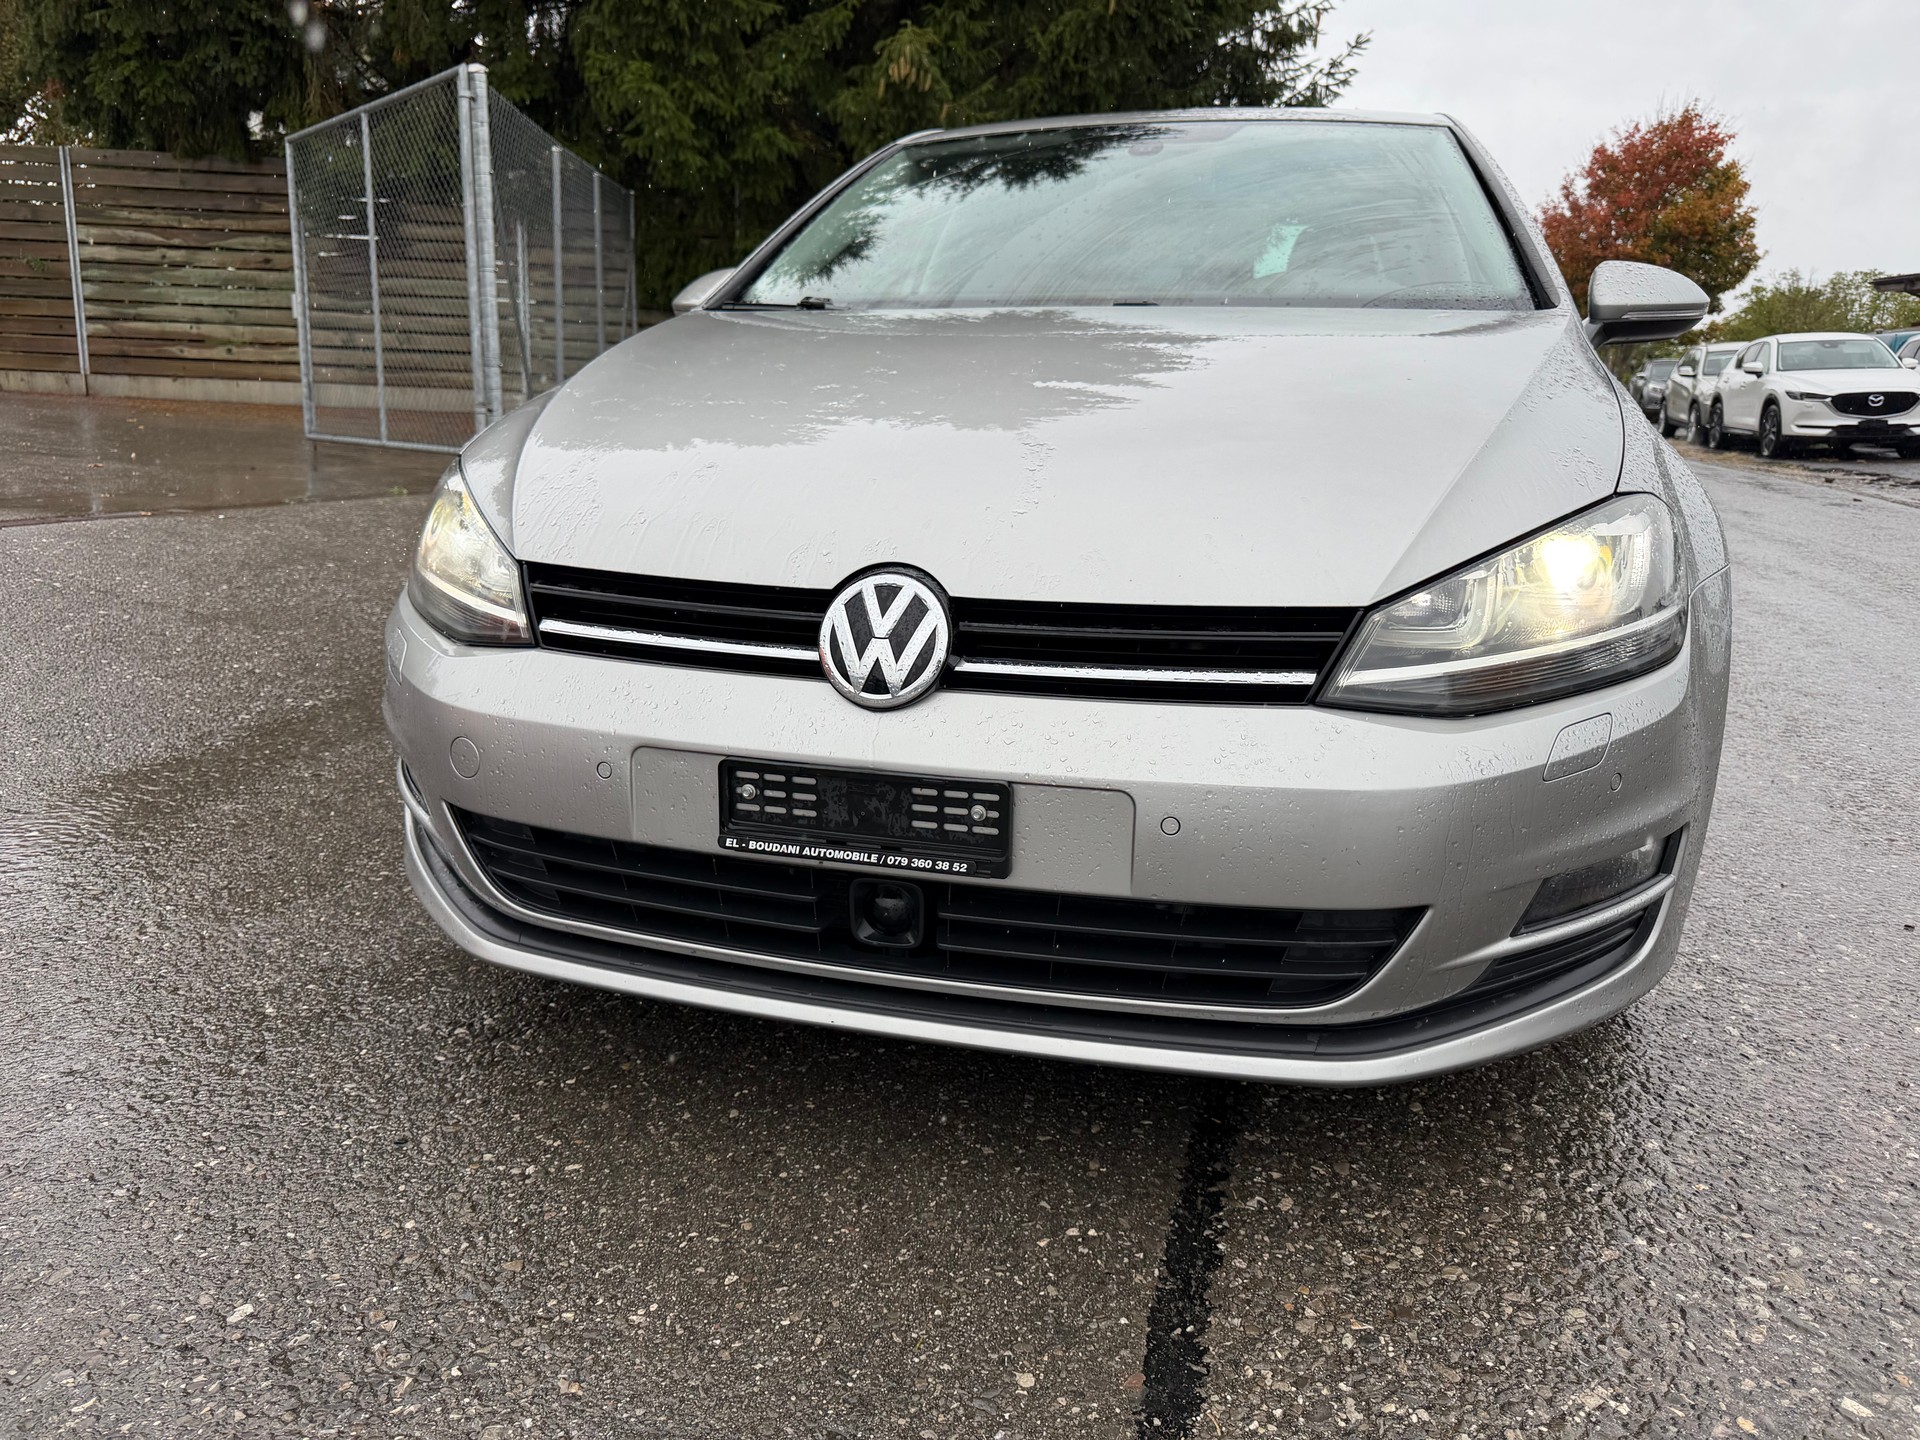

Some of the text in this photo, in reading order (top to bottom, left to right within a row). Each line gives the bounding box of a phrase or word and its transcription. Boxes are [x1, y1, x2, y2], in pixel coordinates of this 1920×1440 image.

[824, 578, 944, 701] VW
[725, 838, 740, 848] EL
[749, 841, 801, 855] BOUDANI
[802, 846, 879, 863] AUTOMOBILE
[887, 856, 909, 866] 079
[911, 859, 933, 869] 360
[935, 861, 950, 871] 38
[952, 863, 968, 872] 52
